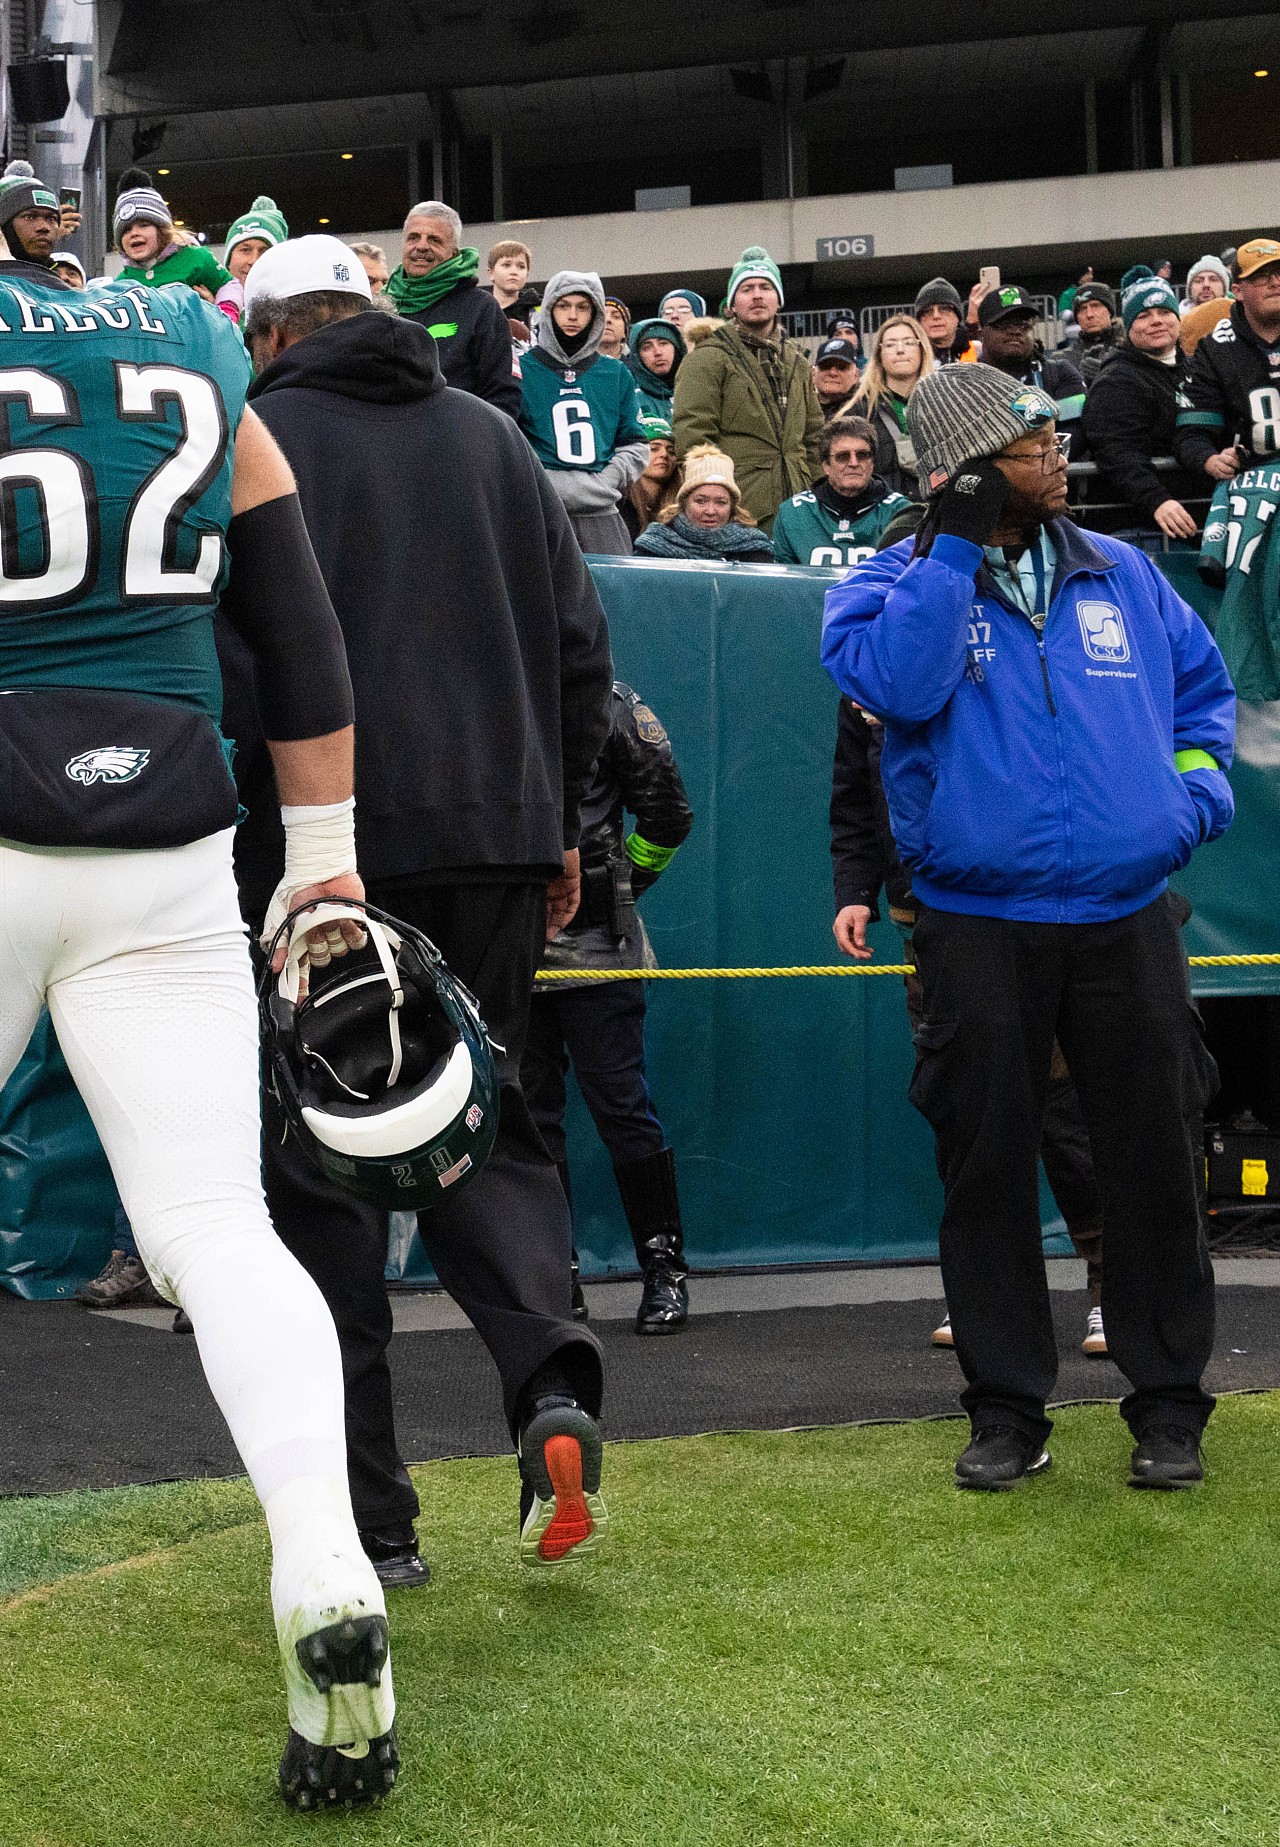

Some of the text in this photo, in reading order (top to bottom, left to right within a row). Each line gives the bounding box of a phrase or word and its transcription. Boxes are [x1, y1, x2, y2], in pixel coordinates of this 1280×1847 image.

[823, 238, 867, 257] 106
[552, 399, 596, 464] 6
[1229, 470, 1280, 492] KELC
[1094, 646, 1120, 657] CSC
[1085, 668, 1137, 679] Supervisor
